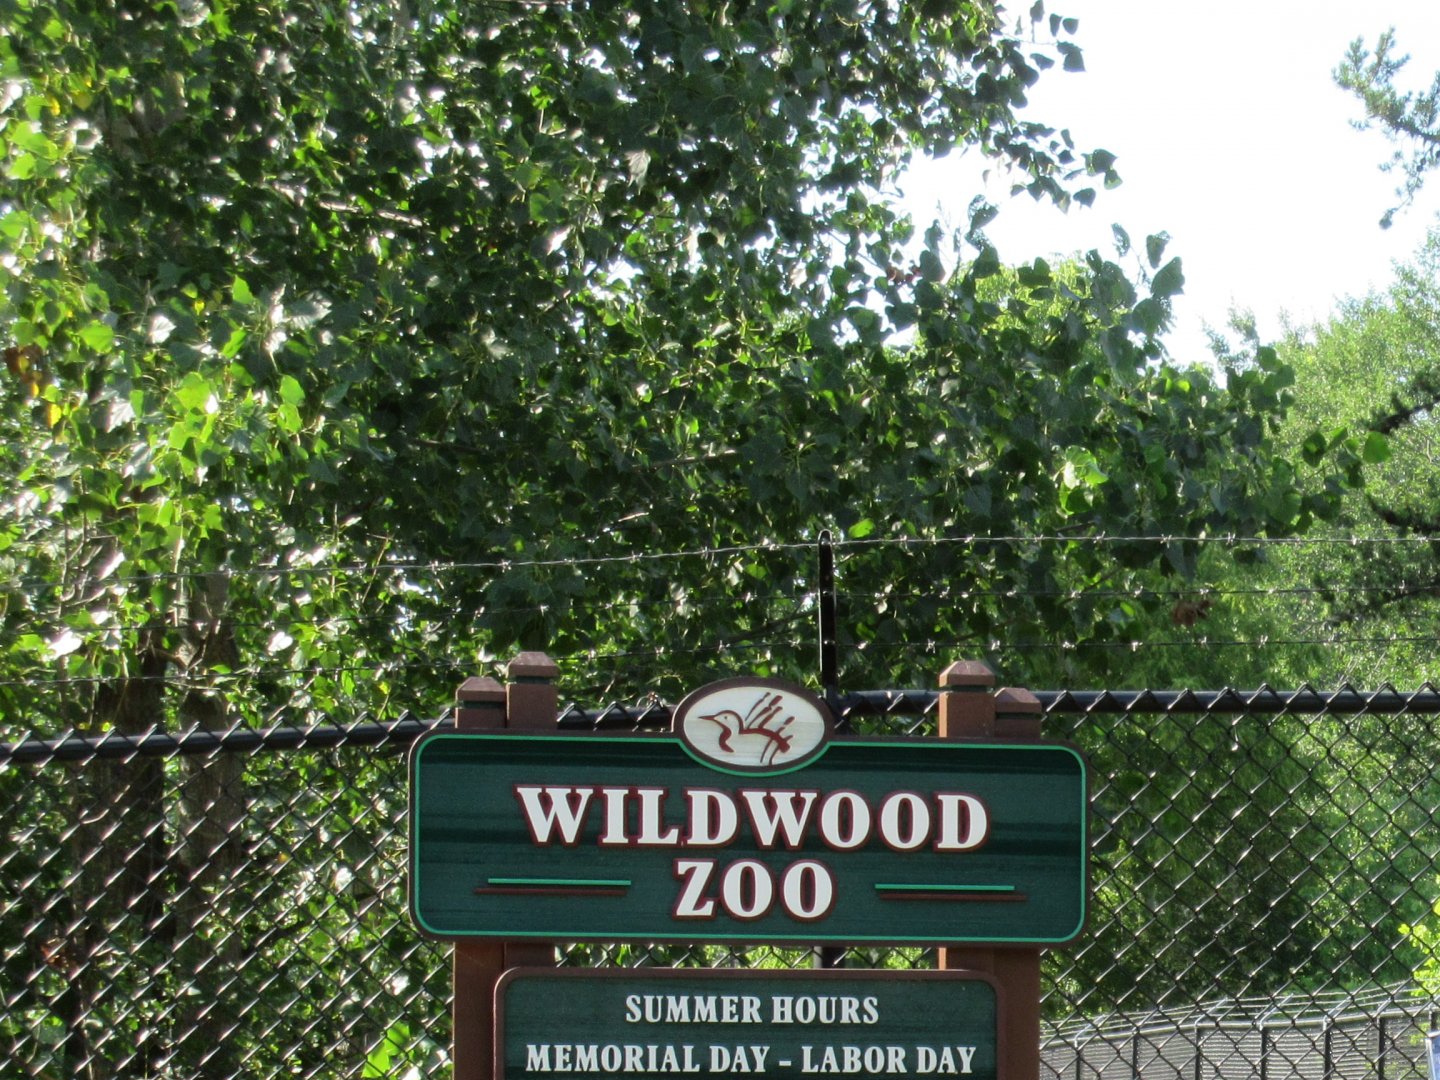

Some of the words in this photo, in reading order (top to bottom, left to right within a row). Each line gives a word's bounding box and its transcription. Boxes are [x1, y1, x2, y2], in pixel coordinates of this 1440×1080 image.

[516, 786, 988, 849] WILDWOOD
[675, 860, 833, 919] ZOO
[625, 994, 763, 1023] SUMMER
[771, 996, 879, 1024] HOURS
[525, 1044, 701, 1073] MEMORIAL
[709, 1045, 771, 1073] DAY
[801, 1045, 908, 1074] LABOR
[916, 1046, 977, 1075] DAY
